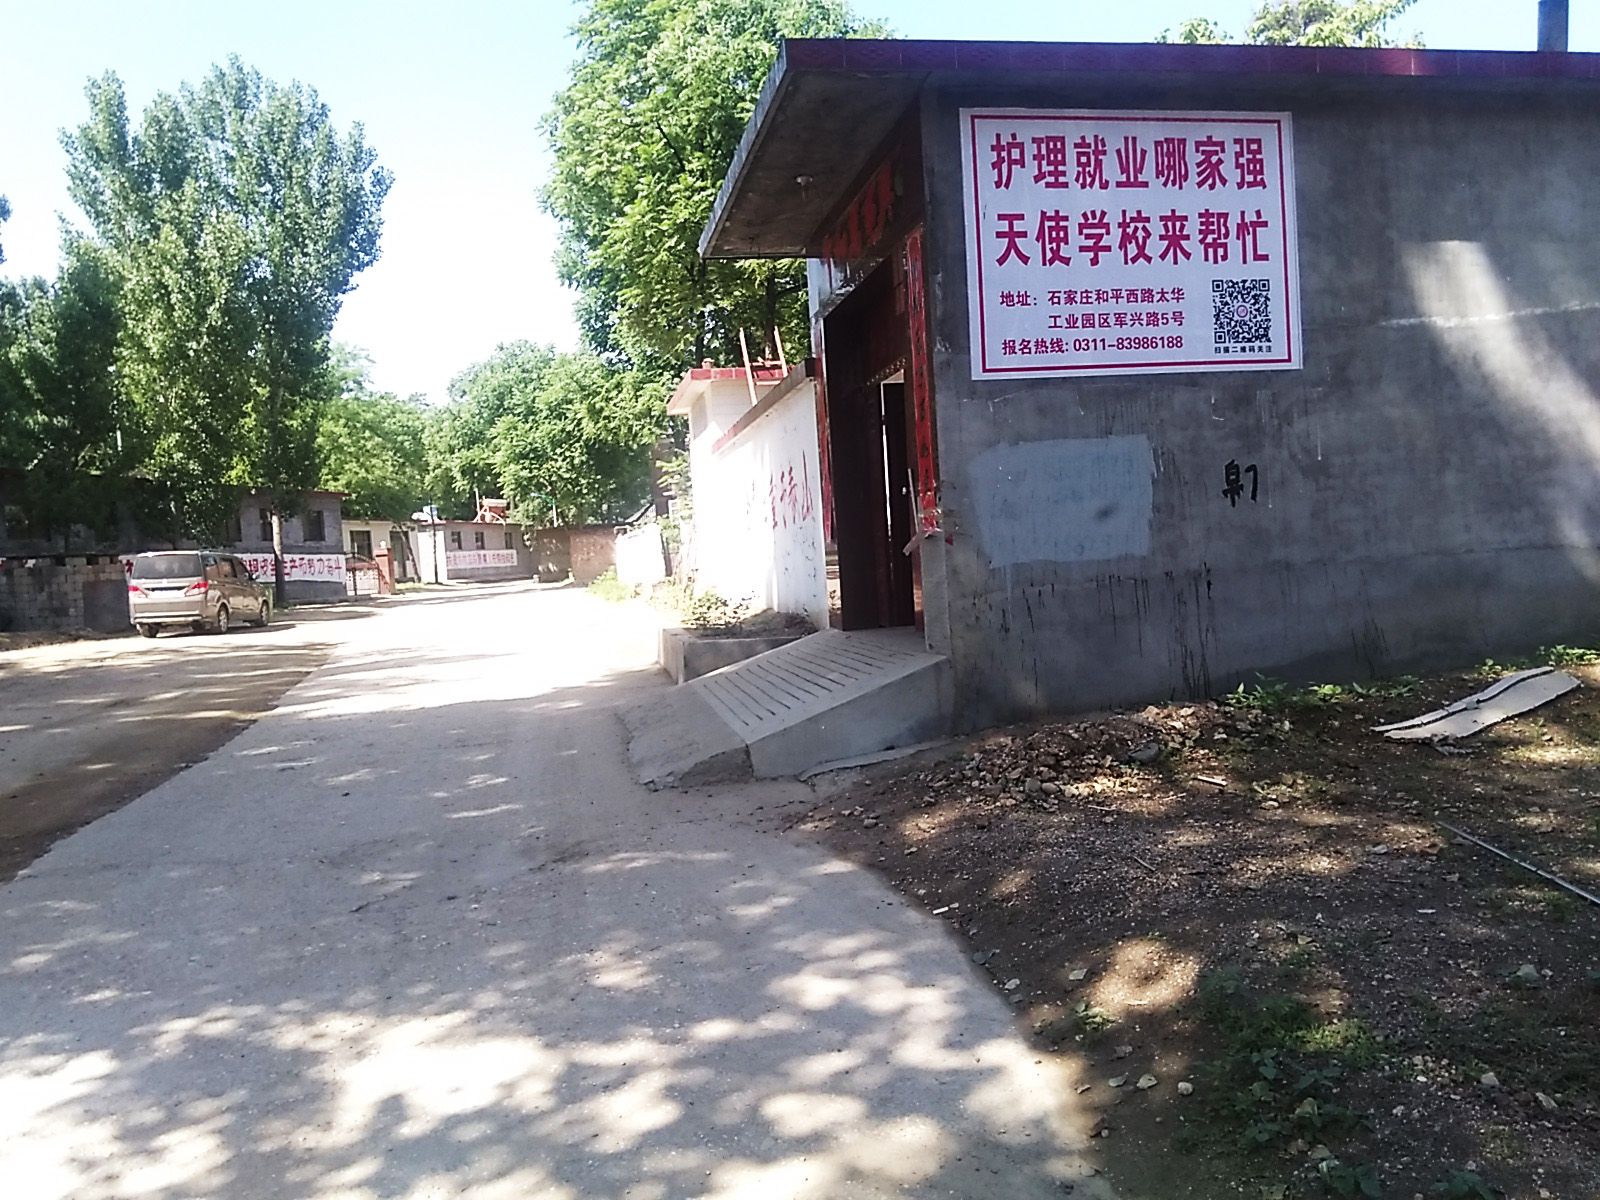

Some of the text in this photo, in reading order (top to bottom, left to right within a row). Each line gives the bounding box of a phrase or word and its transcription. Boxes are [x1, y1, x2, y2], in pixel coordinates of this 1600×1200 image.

[989, 132, 1268, 191] 护理就业哪家强
[994, 208, 1271, 268] 天使学校来帮忙
[1047, 310, 1186, 330] 工业园区军兴路5号
